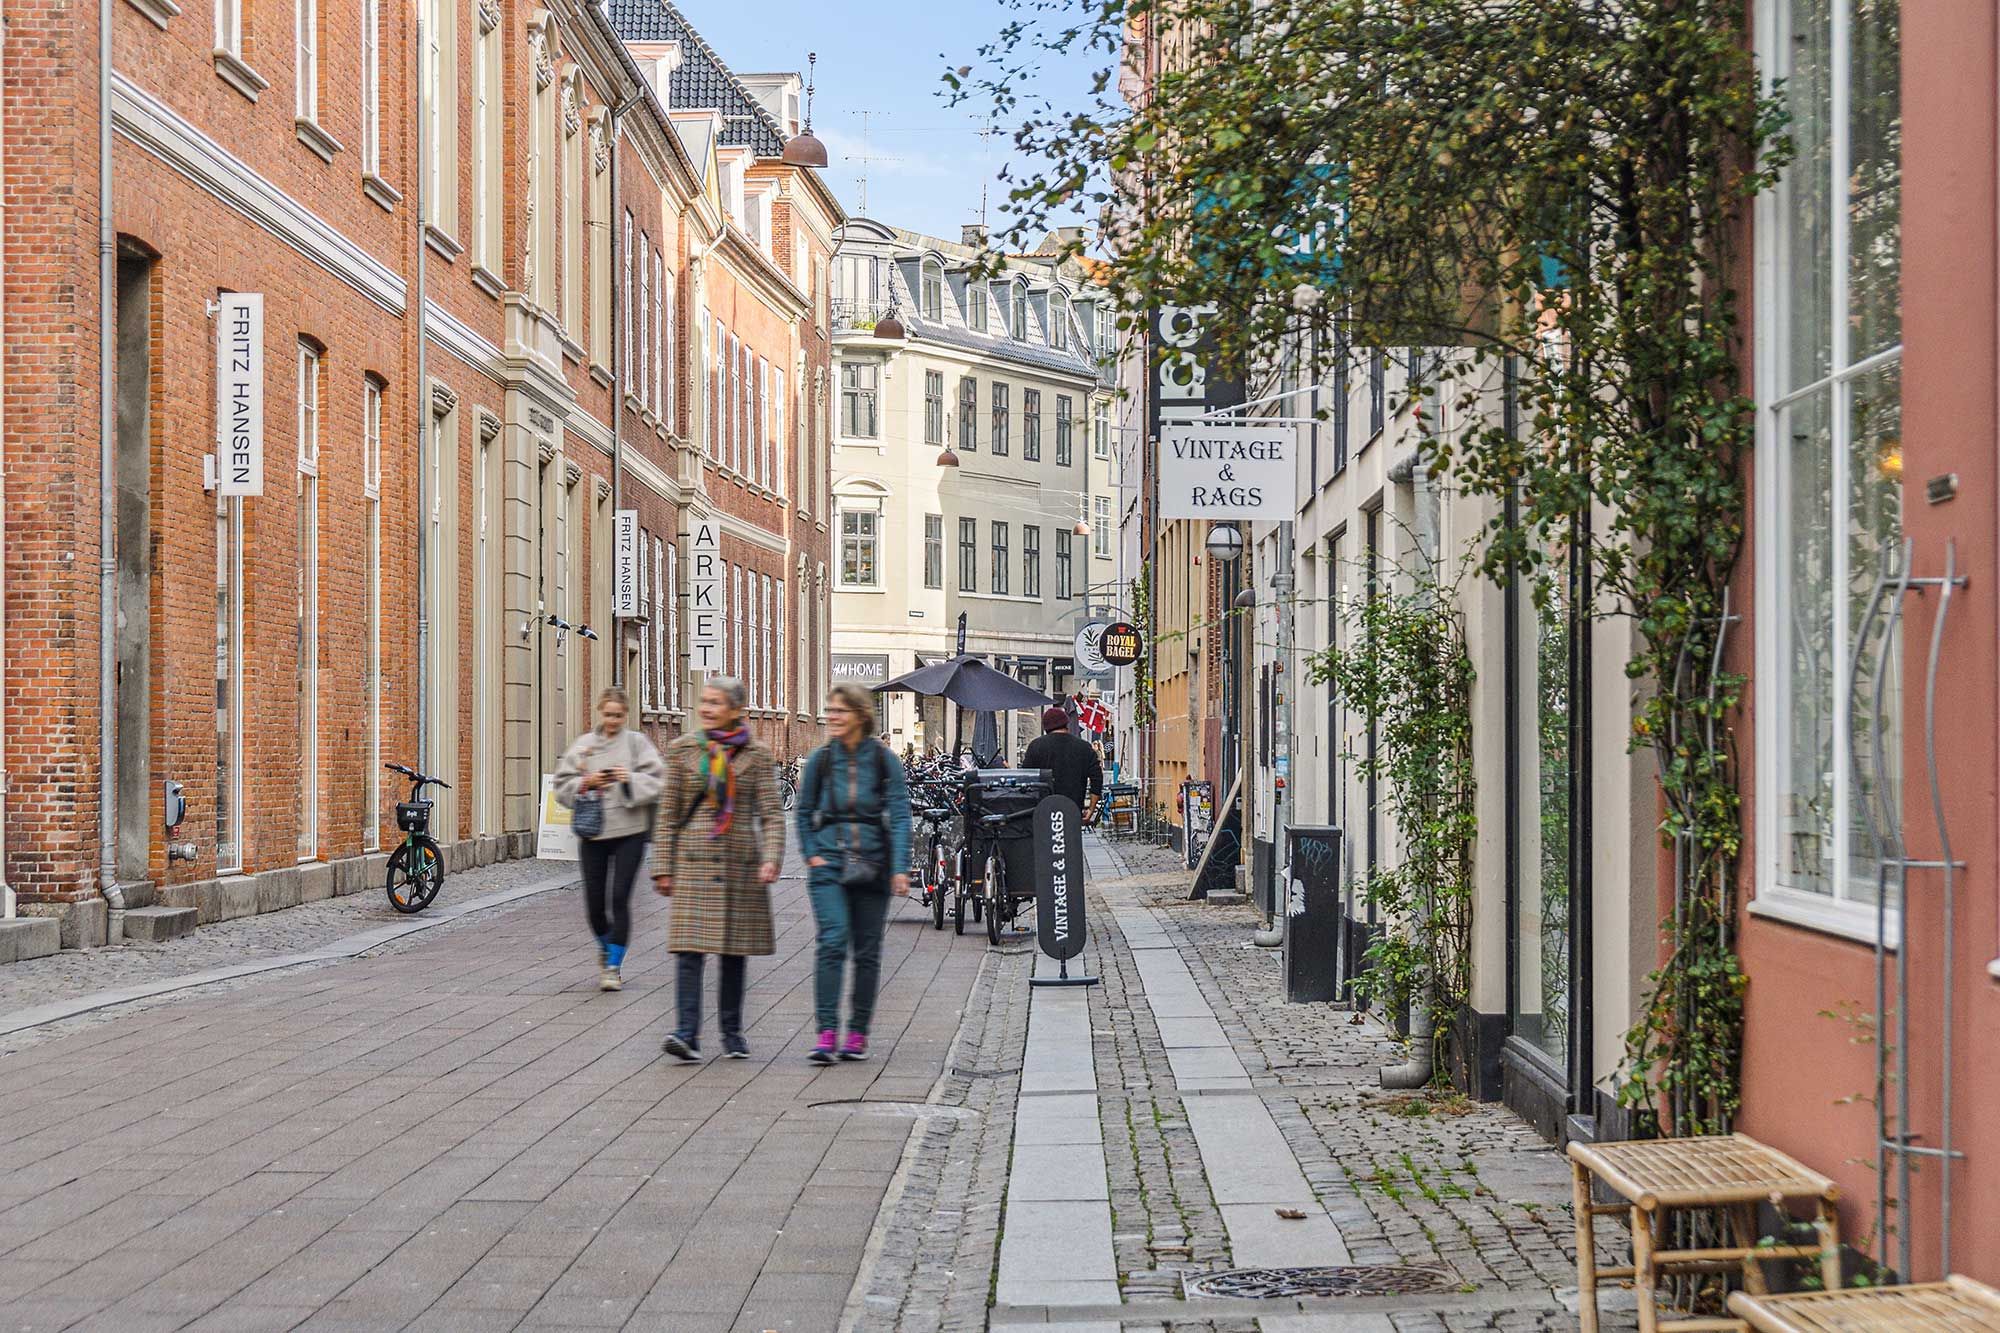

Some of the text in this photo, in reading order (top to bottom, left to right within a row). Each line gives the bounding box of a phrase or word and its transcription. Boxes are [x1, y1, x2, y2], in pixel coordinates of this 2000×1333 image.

[232, 306, 250, 483] FRITZ HANSEN
[1171, 436, 1283, 461] VINTAGE
[1218, 463, 1236, 482] &
[1191, 486, 1262, 507] RAGS
[621, 516, 632, 611] FRITZ HANSEN
[695, 524, 715, 667] ARKET
[1105, 645, 1136, 658] BAGEL
[1106, 634, 1137, 648] ROYAL
[848, 662, 883, 678] HOME
[1051, 811, 1069, 942] VINTAGE & RAGS
